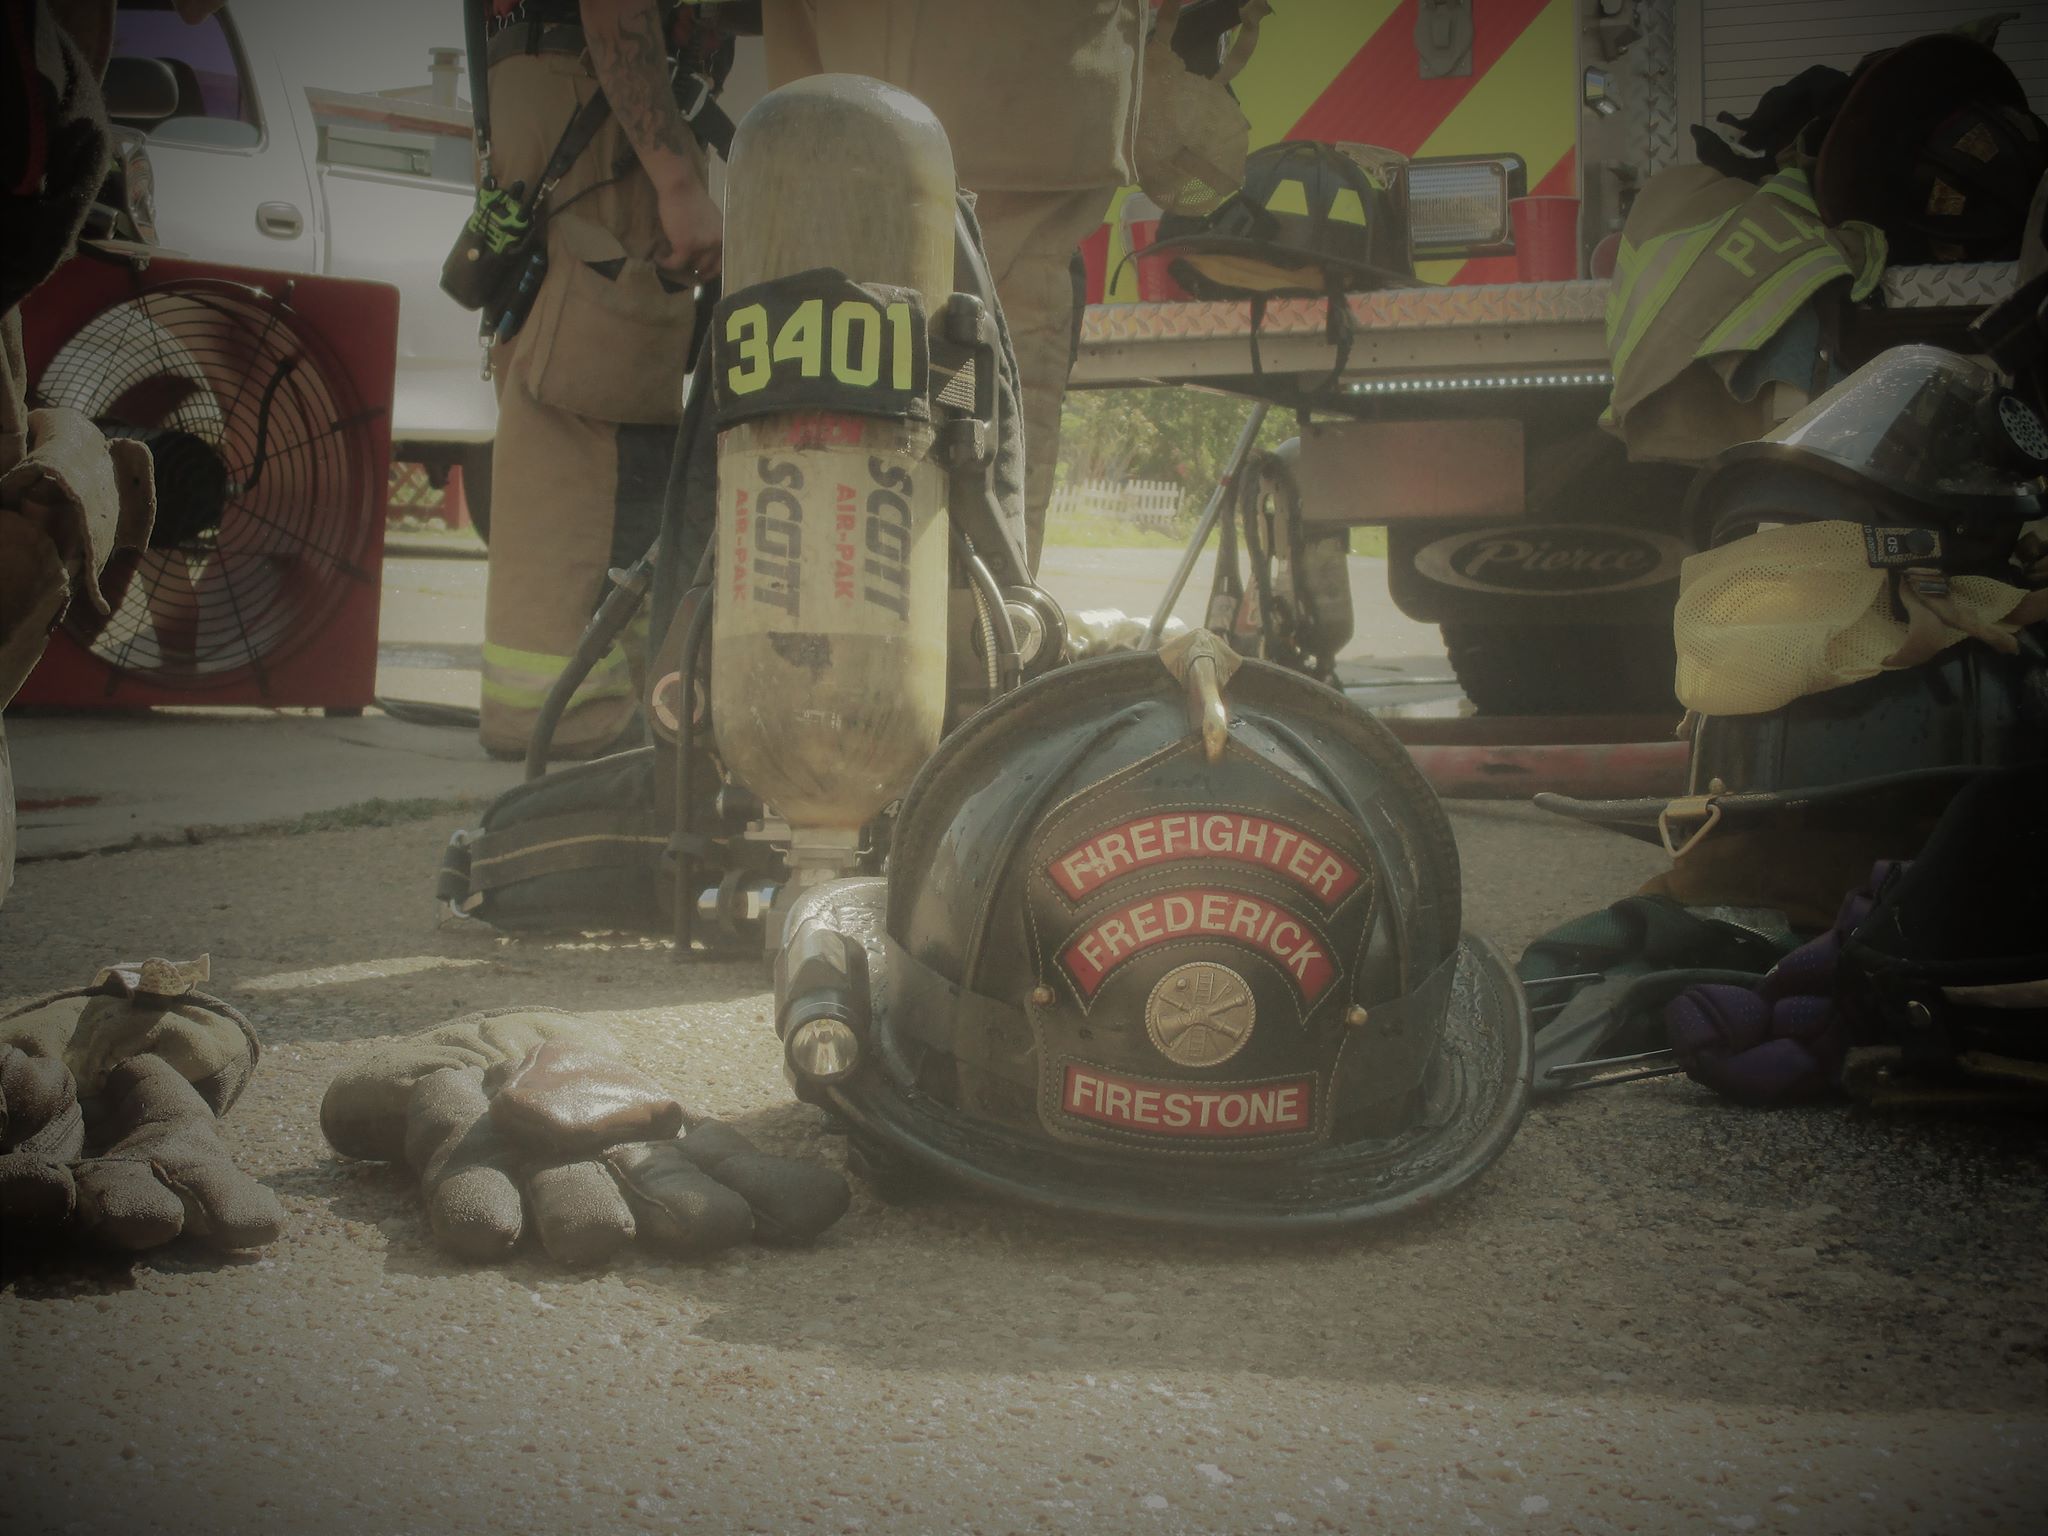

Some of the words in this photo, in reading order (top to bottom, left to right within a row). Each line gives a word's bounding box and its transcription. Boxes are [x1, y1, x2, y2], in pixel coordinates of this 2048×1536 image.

[726, 299, 913, 396] 3401
[753, 455, 805, 618] SCOTT
[834, 483, 857, 602] AIR-PAK
[863, 456, 913, 624] SCOTT
[1464, 539, 1649, 577] Pierce
[1060, 814, 1344, 896] FIREFIGHTER
[1077, 894, 1322, 980] FREDERICK
[1072, 1073, 1300, 1129] FIRESTONE
